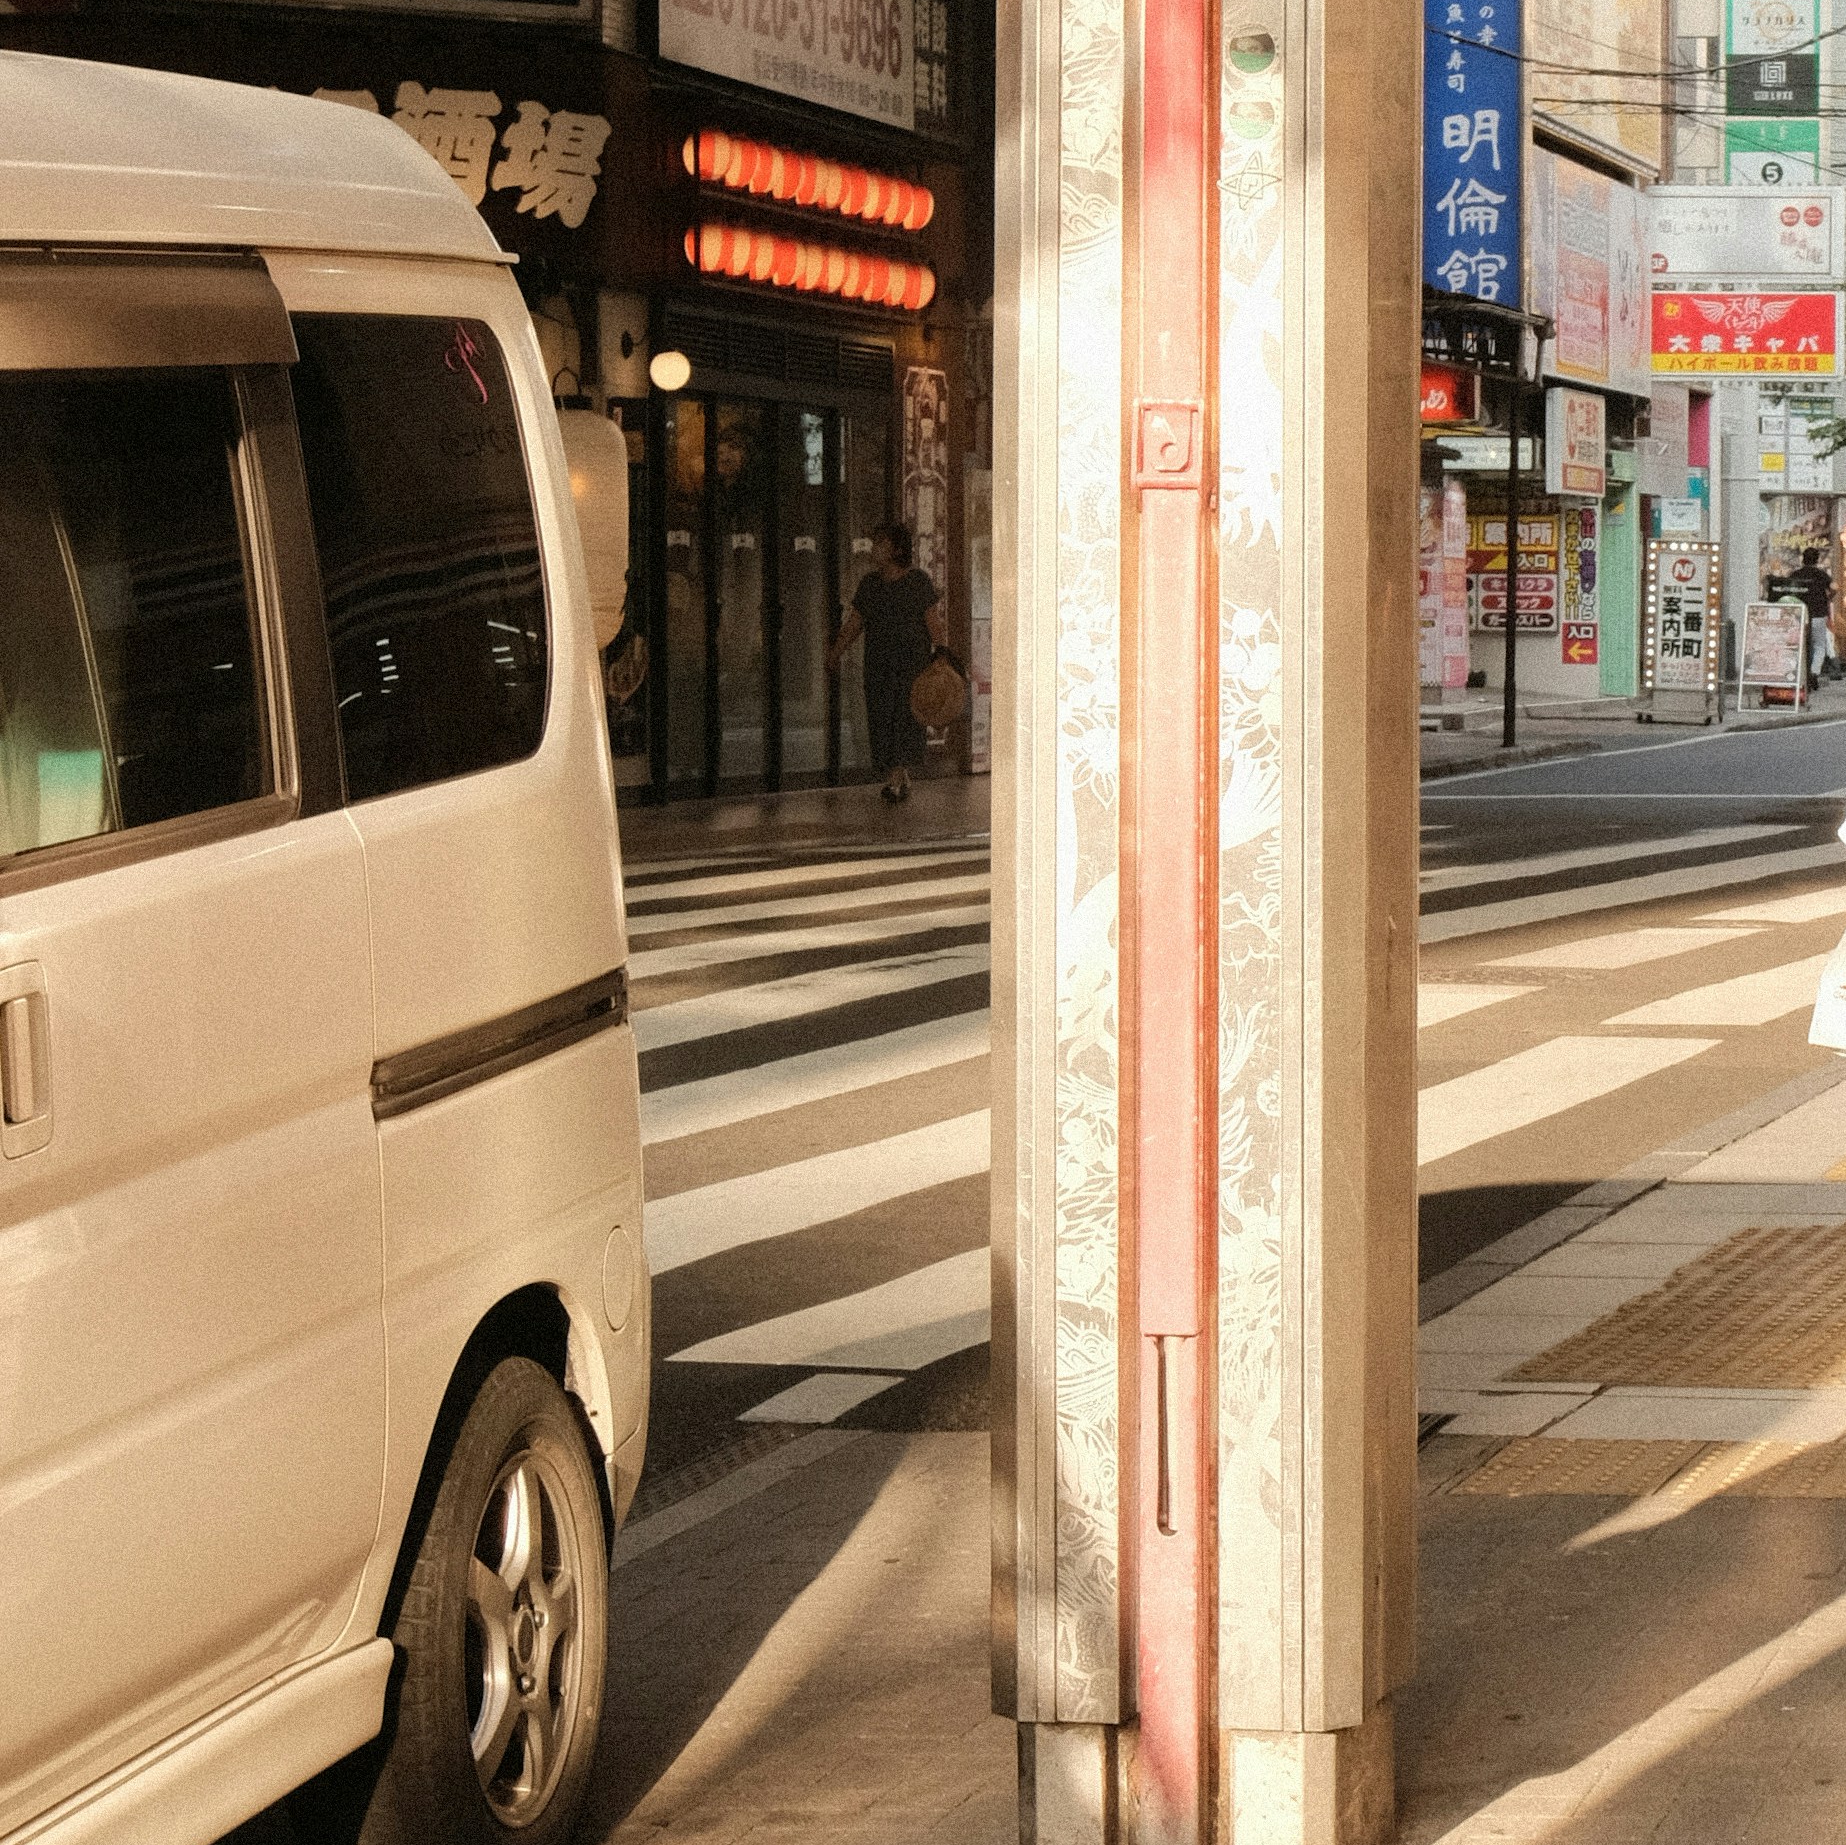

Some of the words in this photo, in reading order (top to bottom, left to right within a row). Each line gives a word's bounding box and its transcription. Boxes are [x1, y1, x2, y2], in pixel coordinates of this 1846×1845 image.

[1436, 109, 1508, 302] 明倫館
[1726, 296, 1762, 315] 天使
[1668, 334, 1820, 353] 大衆キャバ
[1669, 356, 1819, 372] ハイボール飲み放題
[1517, 553, 1549, 569] 入口
[1660, 596, 1682, 659] 案内所
[1683, 586, 1704, 659] 二番町
[1567, 625, 1595, 640] 入口
